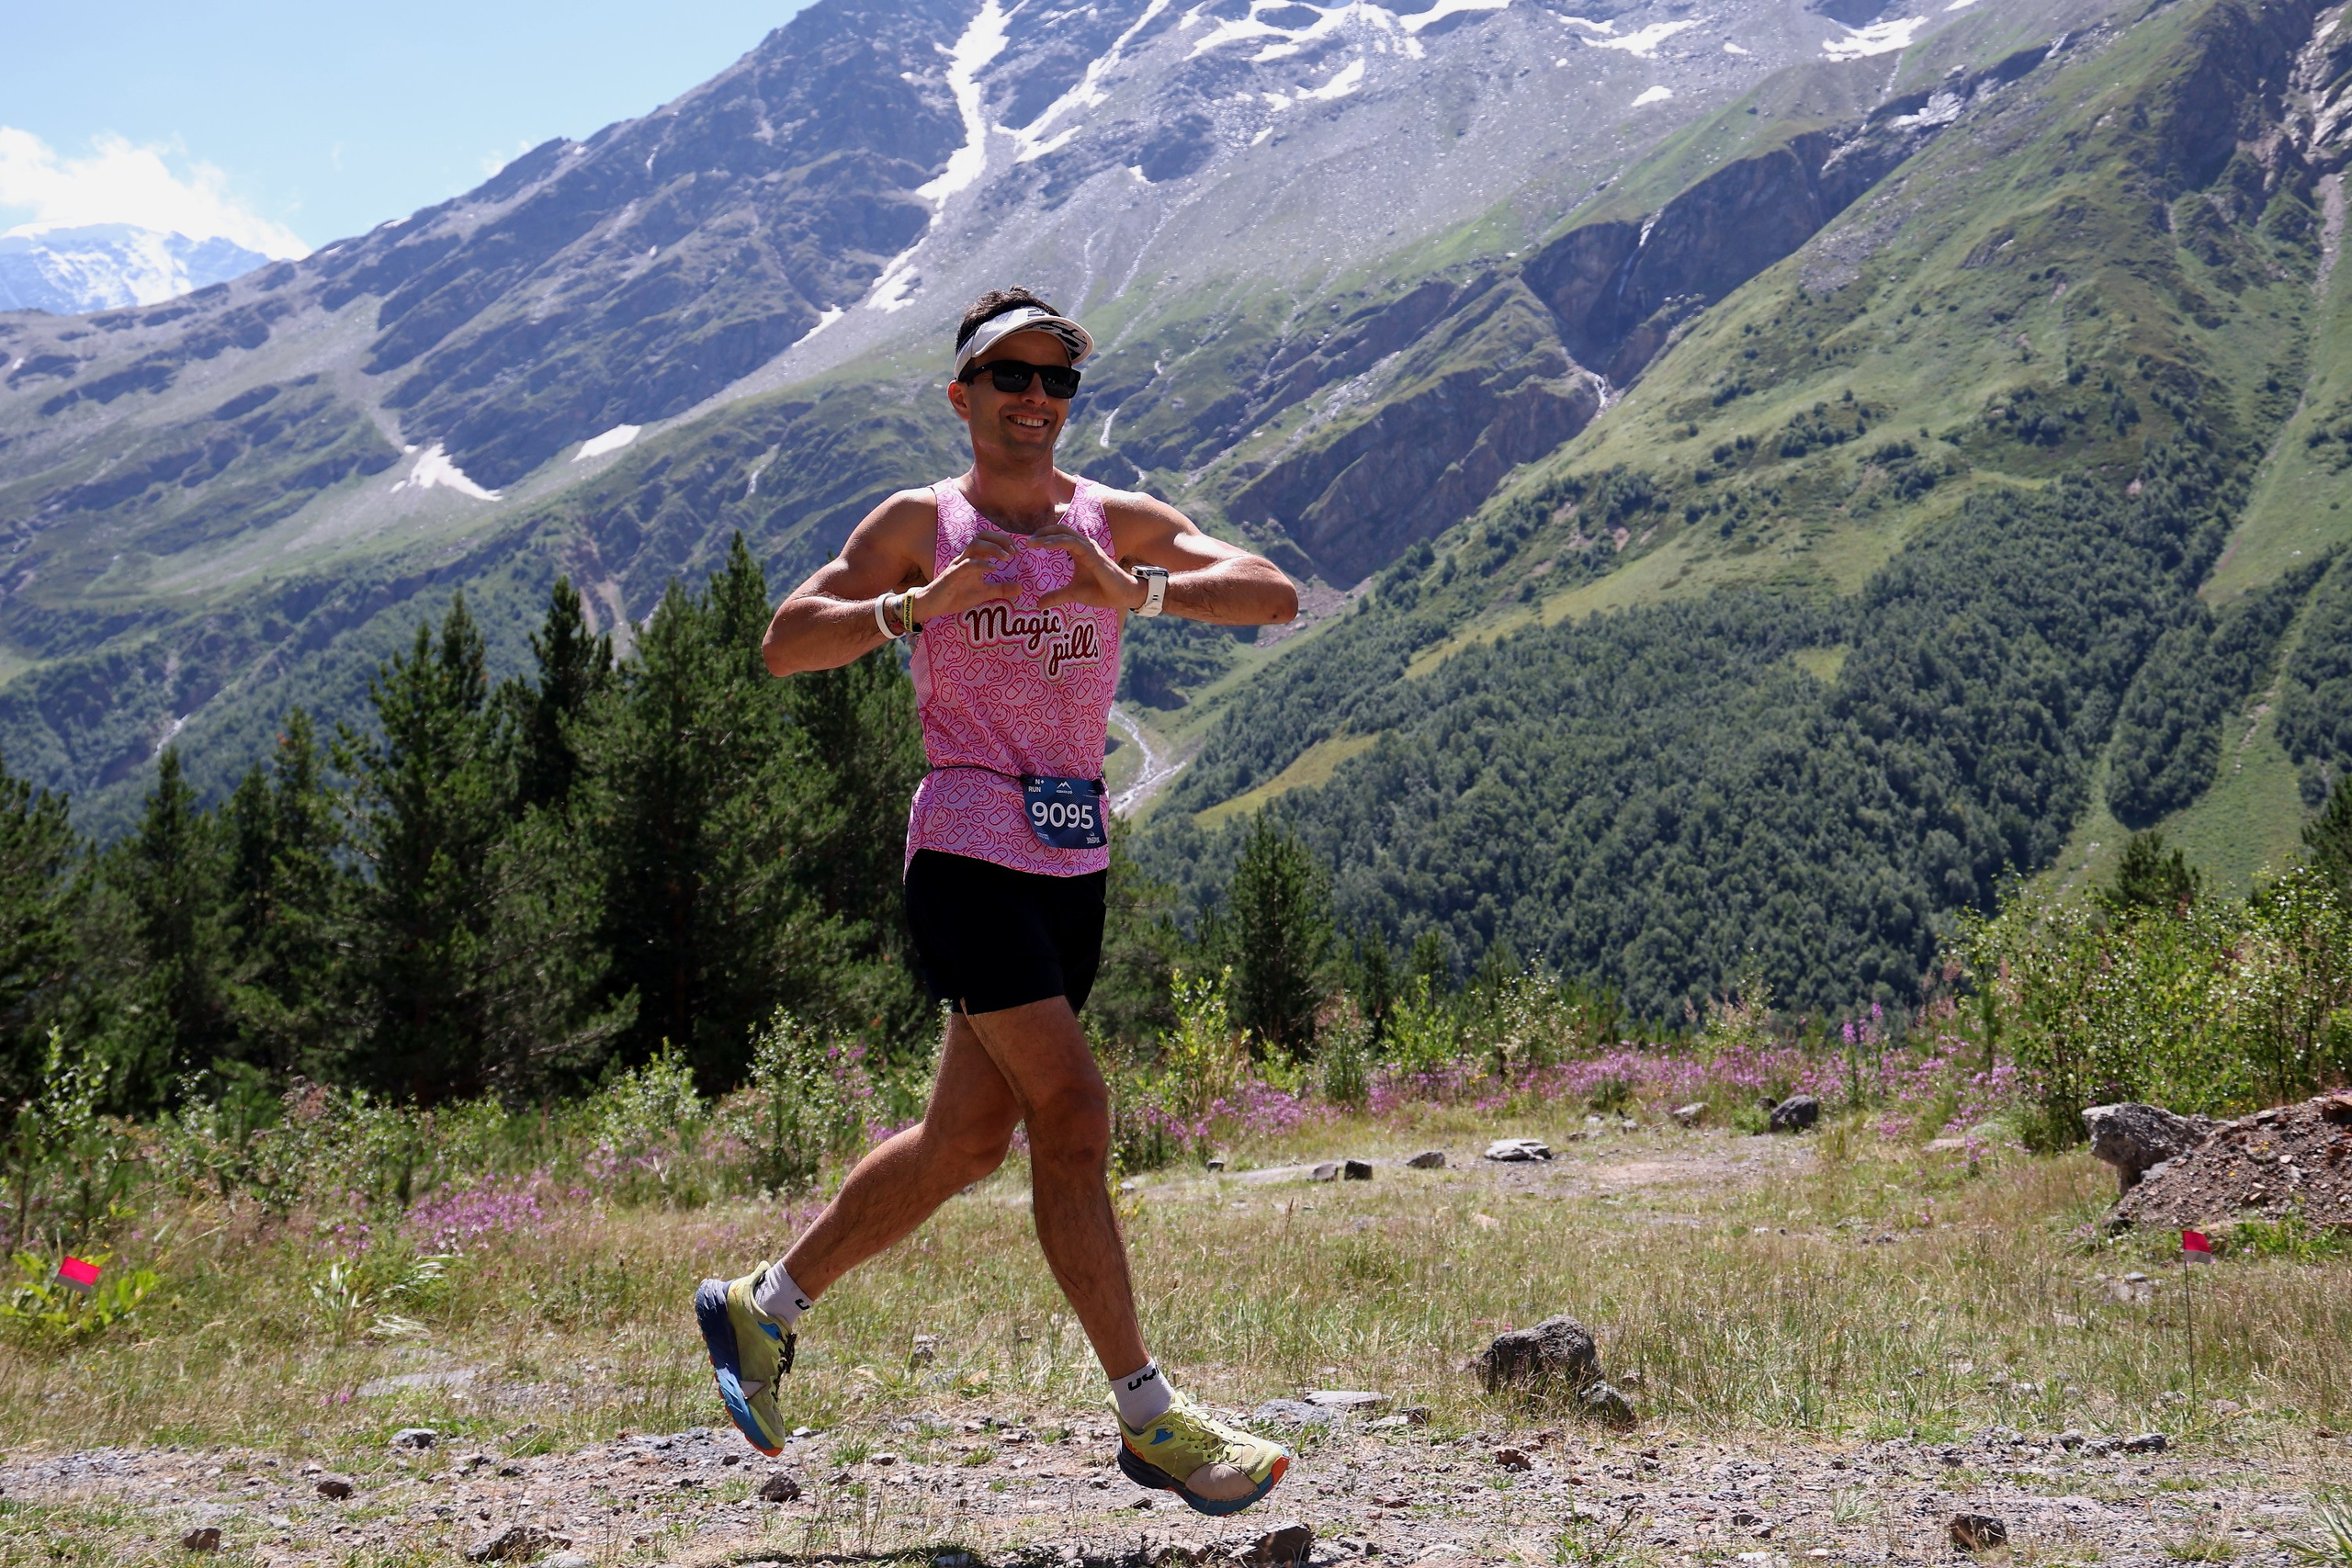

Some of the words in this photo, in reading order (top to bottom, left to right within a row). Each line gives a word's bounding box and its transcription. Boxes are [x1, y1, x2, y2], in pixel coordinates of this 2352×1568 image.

[965, 605, 1061, 650] Magic
[1048, 624, 1099, 676] pills
[1032, 801, 1094, 829] 9095
[1127, 1364, 1159, 1392] UY
